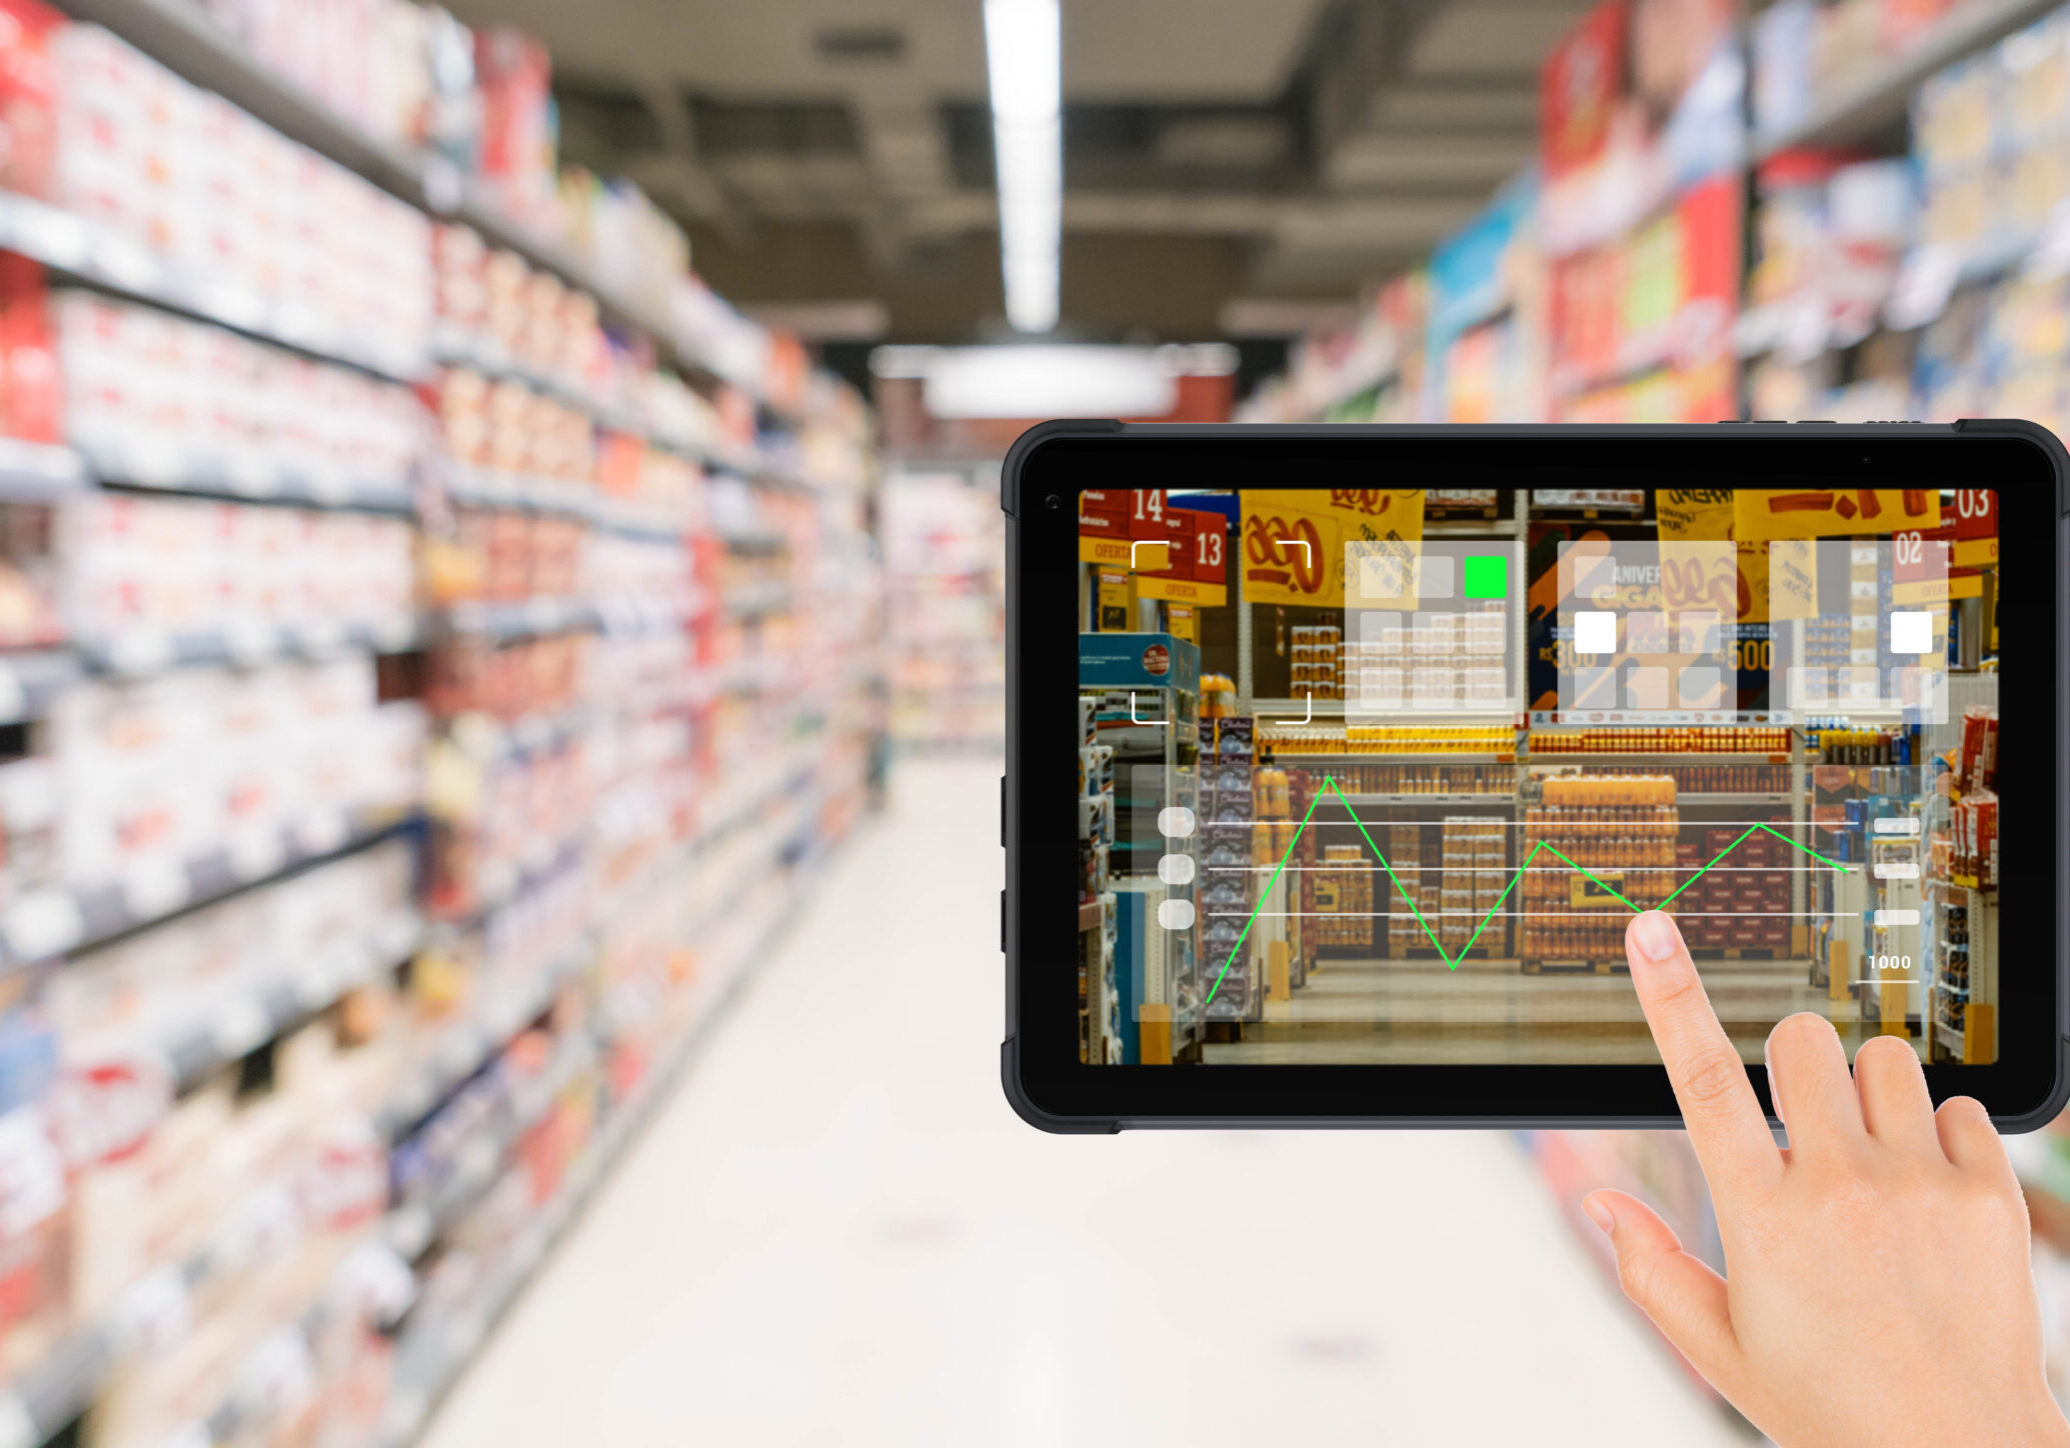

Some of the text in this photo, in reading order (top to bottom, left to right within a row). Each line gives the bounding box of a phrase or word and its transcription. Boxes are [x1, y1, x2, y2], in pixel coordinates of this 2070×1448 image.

[1134, 489, 1162, 521] 14
[1958, 489, 1989, 518] 03
[1198, 533, 1221, 566] 13
[1896, 532, 1922, 565] 02
[1165, 584, 1198, 599] OFERTA
[1728, 640, 1775, 670] 500
[1868, 955, 1911, 969] 1000
